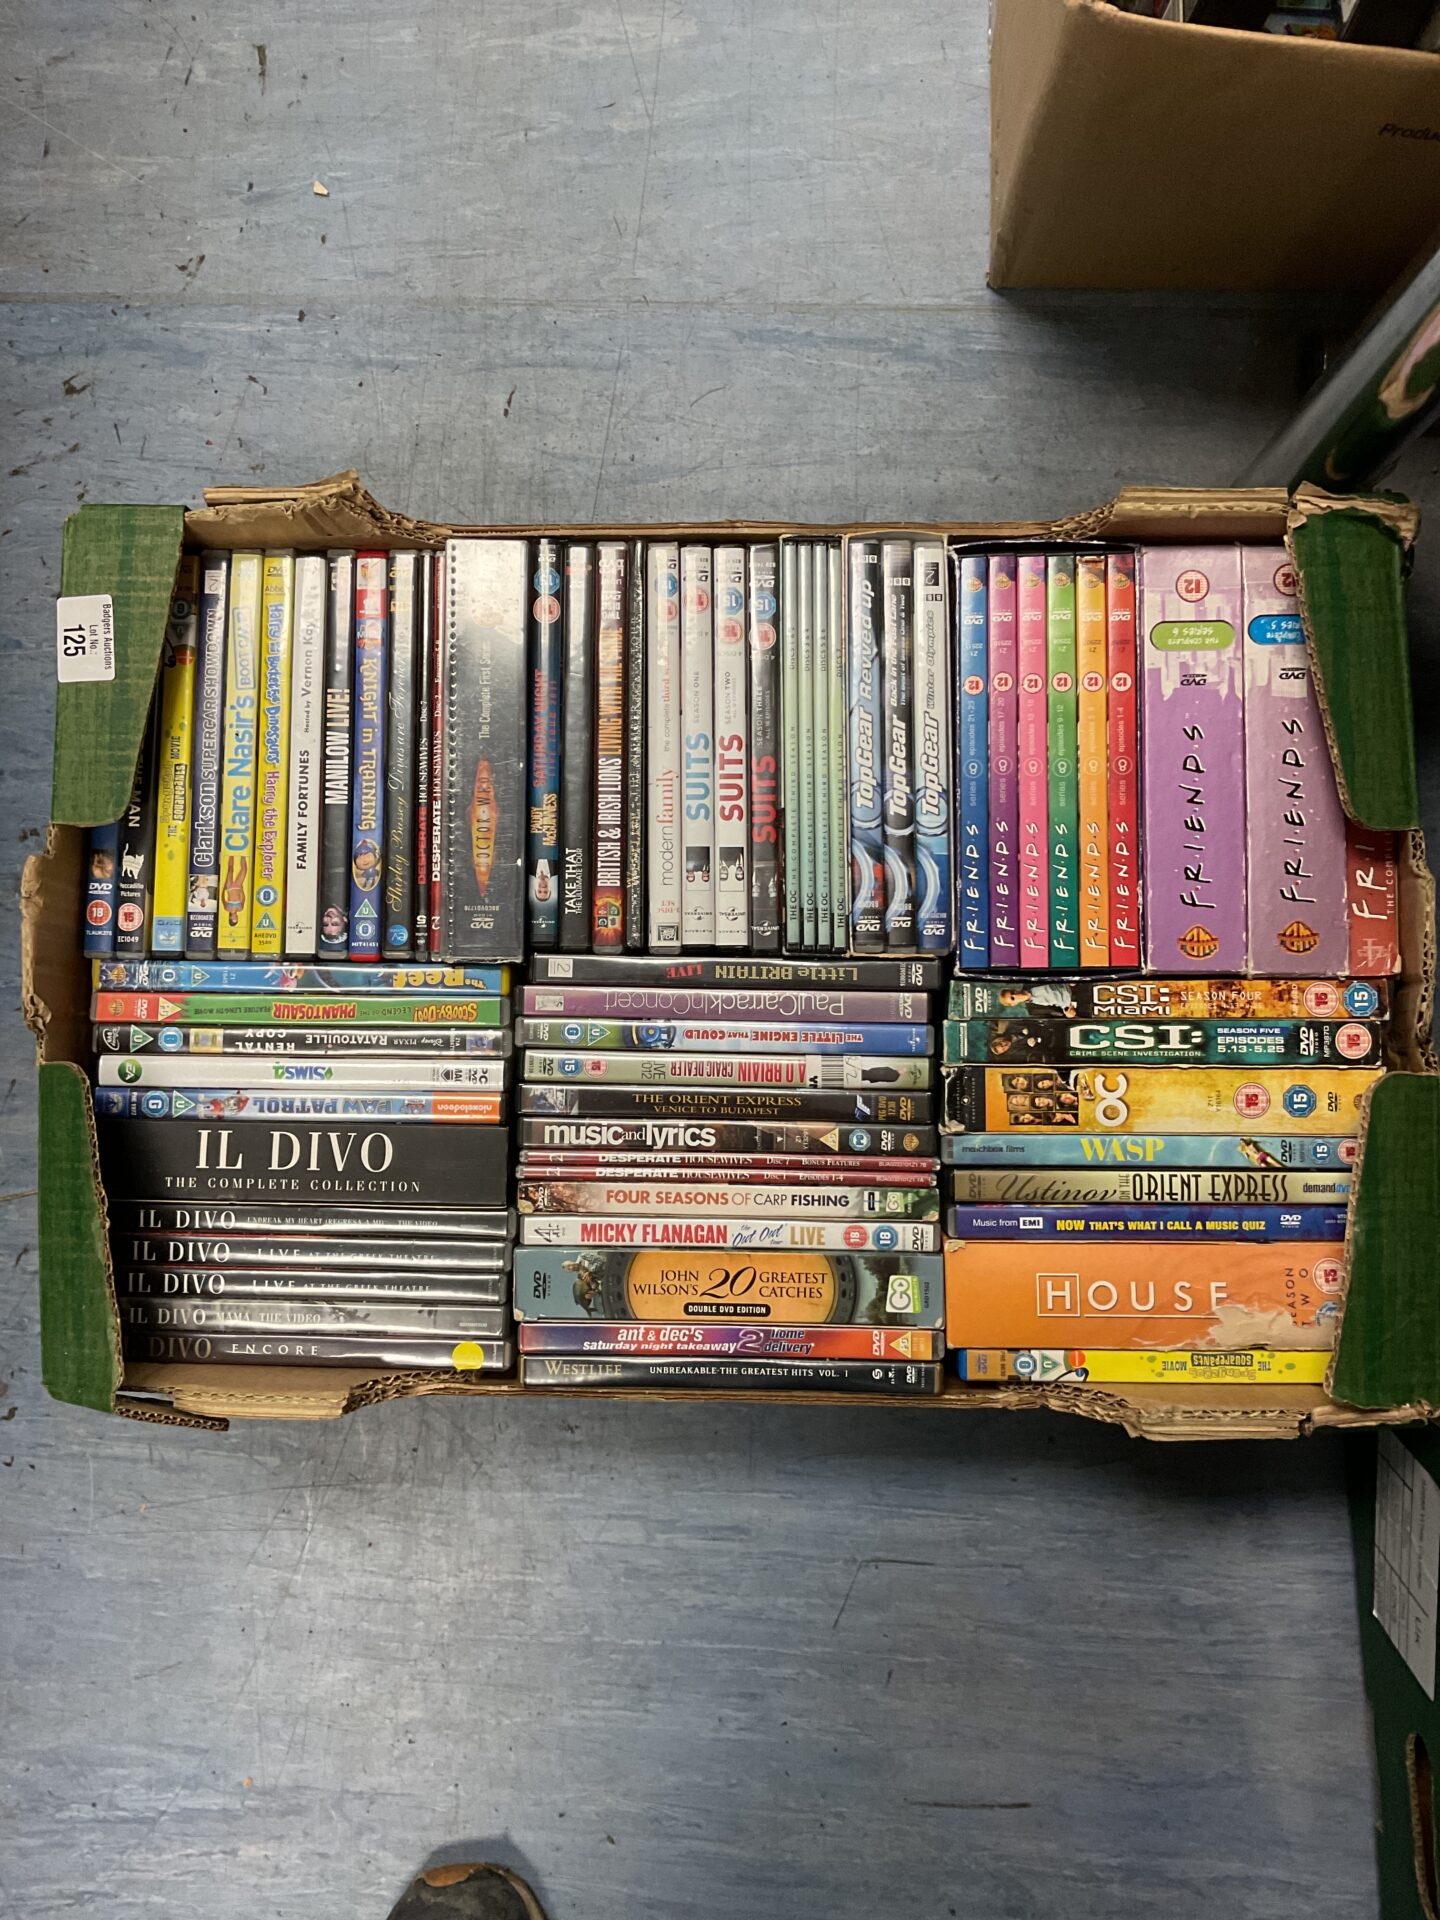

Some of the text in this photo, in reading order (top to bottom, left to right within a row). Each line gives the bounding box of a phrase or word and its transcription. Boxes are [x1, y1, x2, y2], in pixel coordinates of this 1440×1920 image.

[861, 580, 875, 608] up
[63, 624, 85, 657] 125
[89, 624, 99, 640] Lot
[102, 604, 113, 670] Badgers Auctions
[926, 610, 936, 666] Olympics
[860, 616, 873, 700] Revved
[301, 650, 313, 696] Vernon
[479, 667, 491, 722] Complete First
[925, 670, 936, 709] Winter
[534, 669, 547, 788] SATURDAY NIGHT
[193, 609, 218, 867] Clarkson SUPERCAR SHOWDOWN
[325, 689, 350, 804] MANILOW LIVE!
[225, 696, 254, 851] Clare Nasir's
[685, 733, 710, 821] SUITS
[719, 735, 744, 822] SUITS
[597, 718, 622, 886] BRITISH & IRISH LIONS LIVING
[752, 756, 777, 843] SUITS
[297, 750, 309, 870] FAMILY FORTUNES
[418, 738, 428, 884] DESPERATE HOUSEWIVES
[543, 793, 557, 845] McGUINNESS
[260, 771, 281, 879] Harry Explorer
[531, 806, 543, 833] PADDY
[432, 800, 441, 881] DESPERATE
[565, 848, 576, 914] TAKE THAT
[790, 890, 797, 901] OC
[807, 893, 814, 905] OC
[821, 892, 828, 905] OC
[837, 898, 845, 911] OC
[665, 964, 858, 979] Little BRITAIN LIVE
[1093, 986, 1261, 1004] CSI: SEASON FOUR
[272, 1001, 357, 1017] PHANTOSAUR
[305, 1033, 387, 1048] RATATOUILLE
[683, 1030, 843, 1043] LITTLE ENGINE COULD
[1069, 1025, 1202, 1049] CSI:
[671, 1061, 705, 1076] DEALER
[253, 1098, 393, 1113] PAW PATROL
[437, 1103, 492, 1113] nickelodeon
[632, 1094, 801, 1107] THE ORIENT EXPRESS
[654, 1106, 779, 1115] VENICE TO BUDAPEST
[196, 1130, 393, 1173] IL DIVO
[1006, 1145, 1024, 1153] films
[1080, 1138, 1164, 1161] WASP
[599, 1155, 680, 1163] DESPERATE
[166, 1177, 420, 1192] THE COMPLETE COLLECTION
[1132, 1174, 1288, 1202] ORIENT EXPRESS
[655, 1192, 728, 1205] SEASONS
[732, 1193, 751, 1206] OF
[754, 1194, 787, 1206] CARP
[791, 1195, 849, 1207] FISHING
[139, 1210, 236, 1229] IL DIVO
[973, 1219, 1017, 1227] Music from
[1056, 1219, 1265, 1230] NOW THAT'S WHAT CALL MUSIC QUIZ
[581, 1224, 727, 1244] MICKY FLANAGAN
[790, 1226, 825, 1245] LIVE
[133, 1241, 230, 1262] IL DIVO
[129, 1273, 225, 1294] IL DIVO
[660, 1270, 699, 1282] JOHN
[700, 1266, 756, 1299] 20
[759, 1272, 828, 1284] GREATEST
[633, 1284, 698, 1296] WILSON'S
[759, 1286, 823, 1298] CATCHES
[1046, 1281, 1228, 1312] HOUSE
[130, 1308, 320, 1325] IL DIVO THE VIDEO
[737, 1306, 766, 1314] EDITION
[618, 1327, 703, 1341] ant dec's
[737, 1329, 763, 1352] 2
[770, 1329, 804, 1338] home
[232, 1344, 318, 1355] ENCORE
[583, 1341, 736, 1353] saturday night takeaway
[763, 1342, 814, 1354] delivery
[545, 1361, 622, 1376] WESTLIFE
[741, 1368, 788, 1376] GREATEST
[791, 1368, 813, 1376] HITS
[1162, 1361, 1187, 1370] MOVIE
